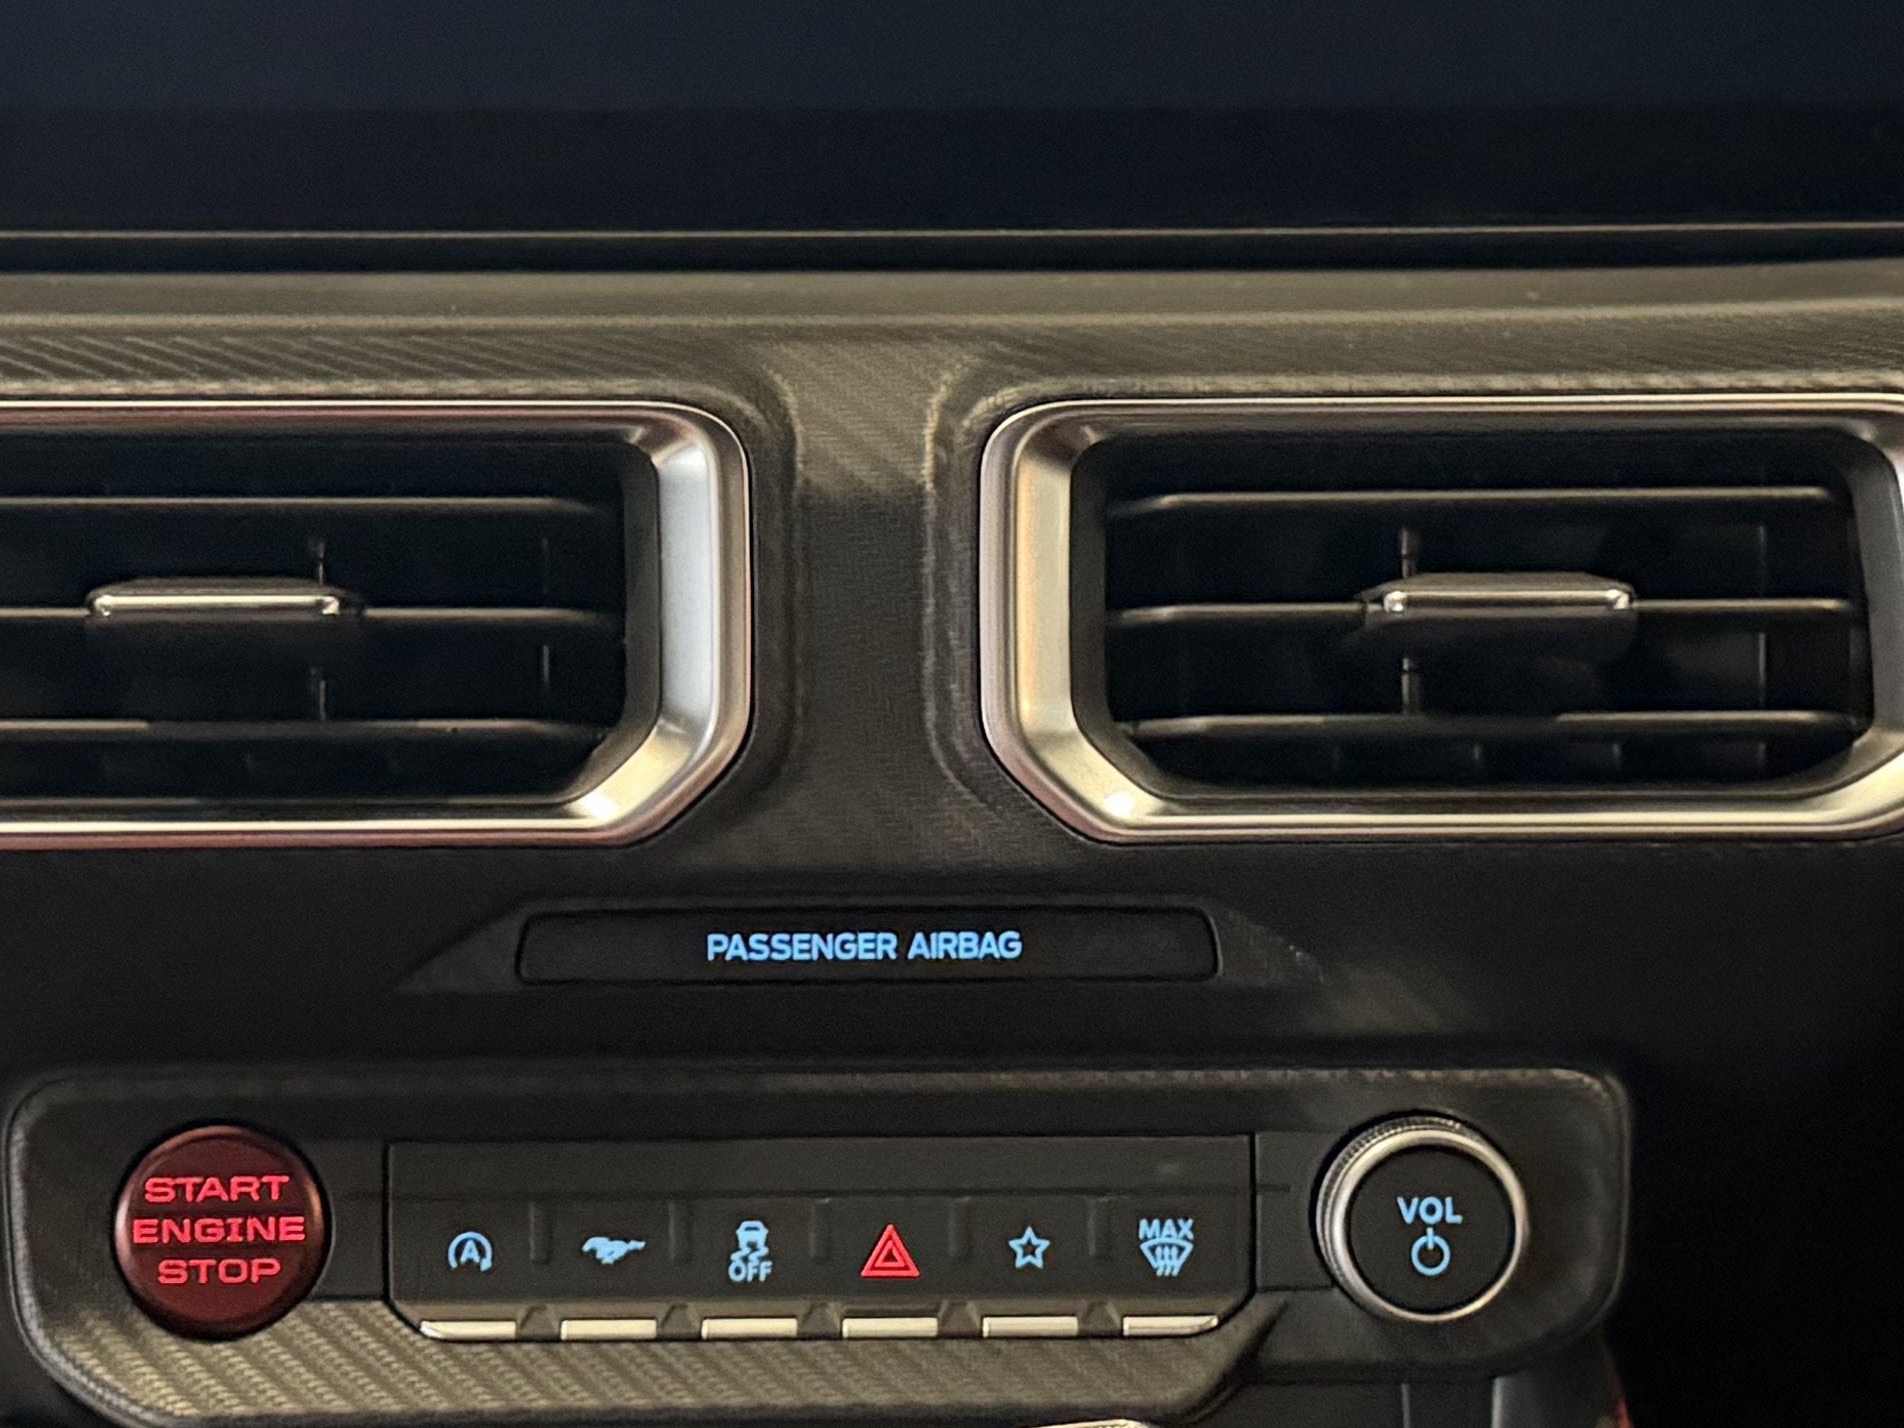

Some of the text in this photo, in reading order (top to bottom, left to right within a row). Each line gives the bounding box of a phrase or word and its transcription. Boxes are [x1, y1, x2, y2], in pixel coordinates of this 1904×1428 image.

[706, 930, 1024, 963] PASSENGER AIRBAG
[144, 1174, 289, 1204] START
[1397, 1194, 1462, 1226] VOL
[132, 1215, 306, 1245] ENGINE
[1138, 1218, 1194, 1241] MAX
[158, 1258, 282, 1286] STOP
[728, 1259, 773, 1283] OFF
